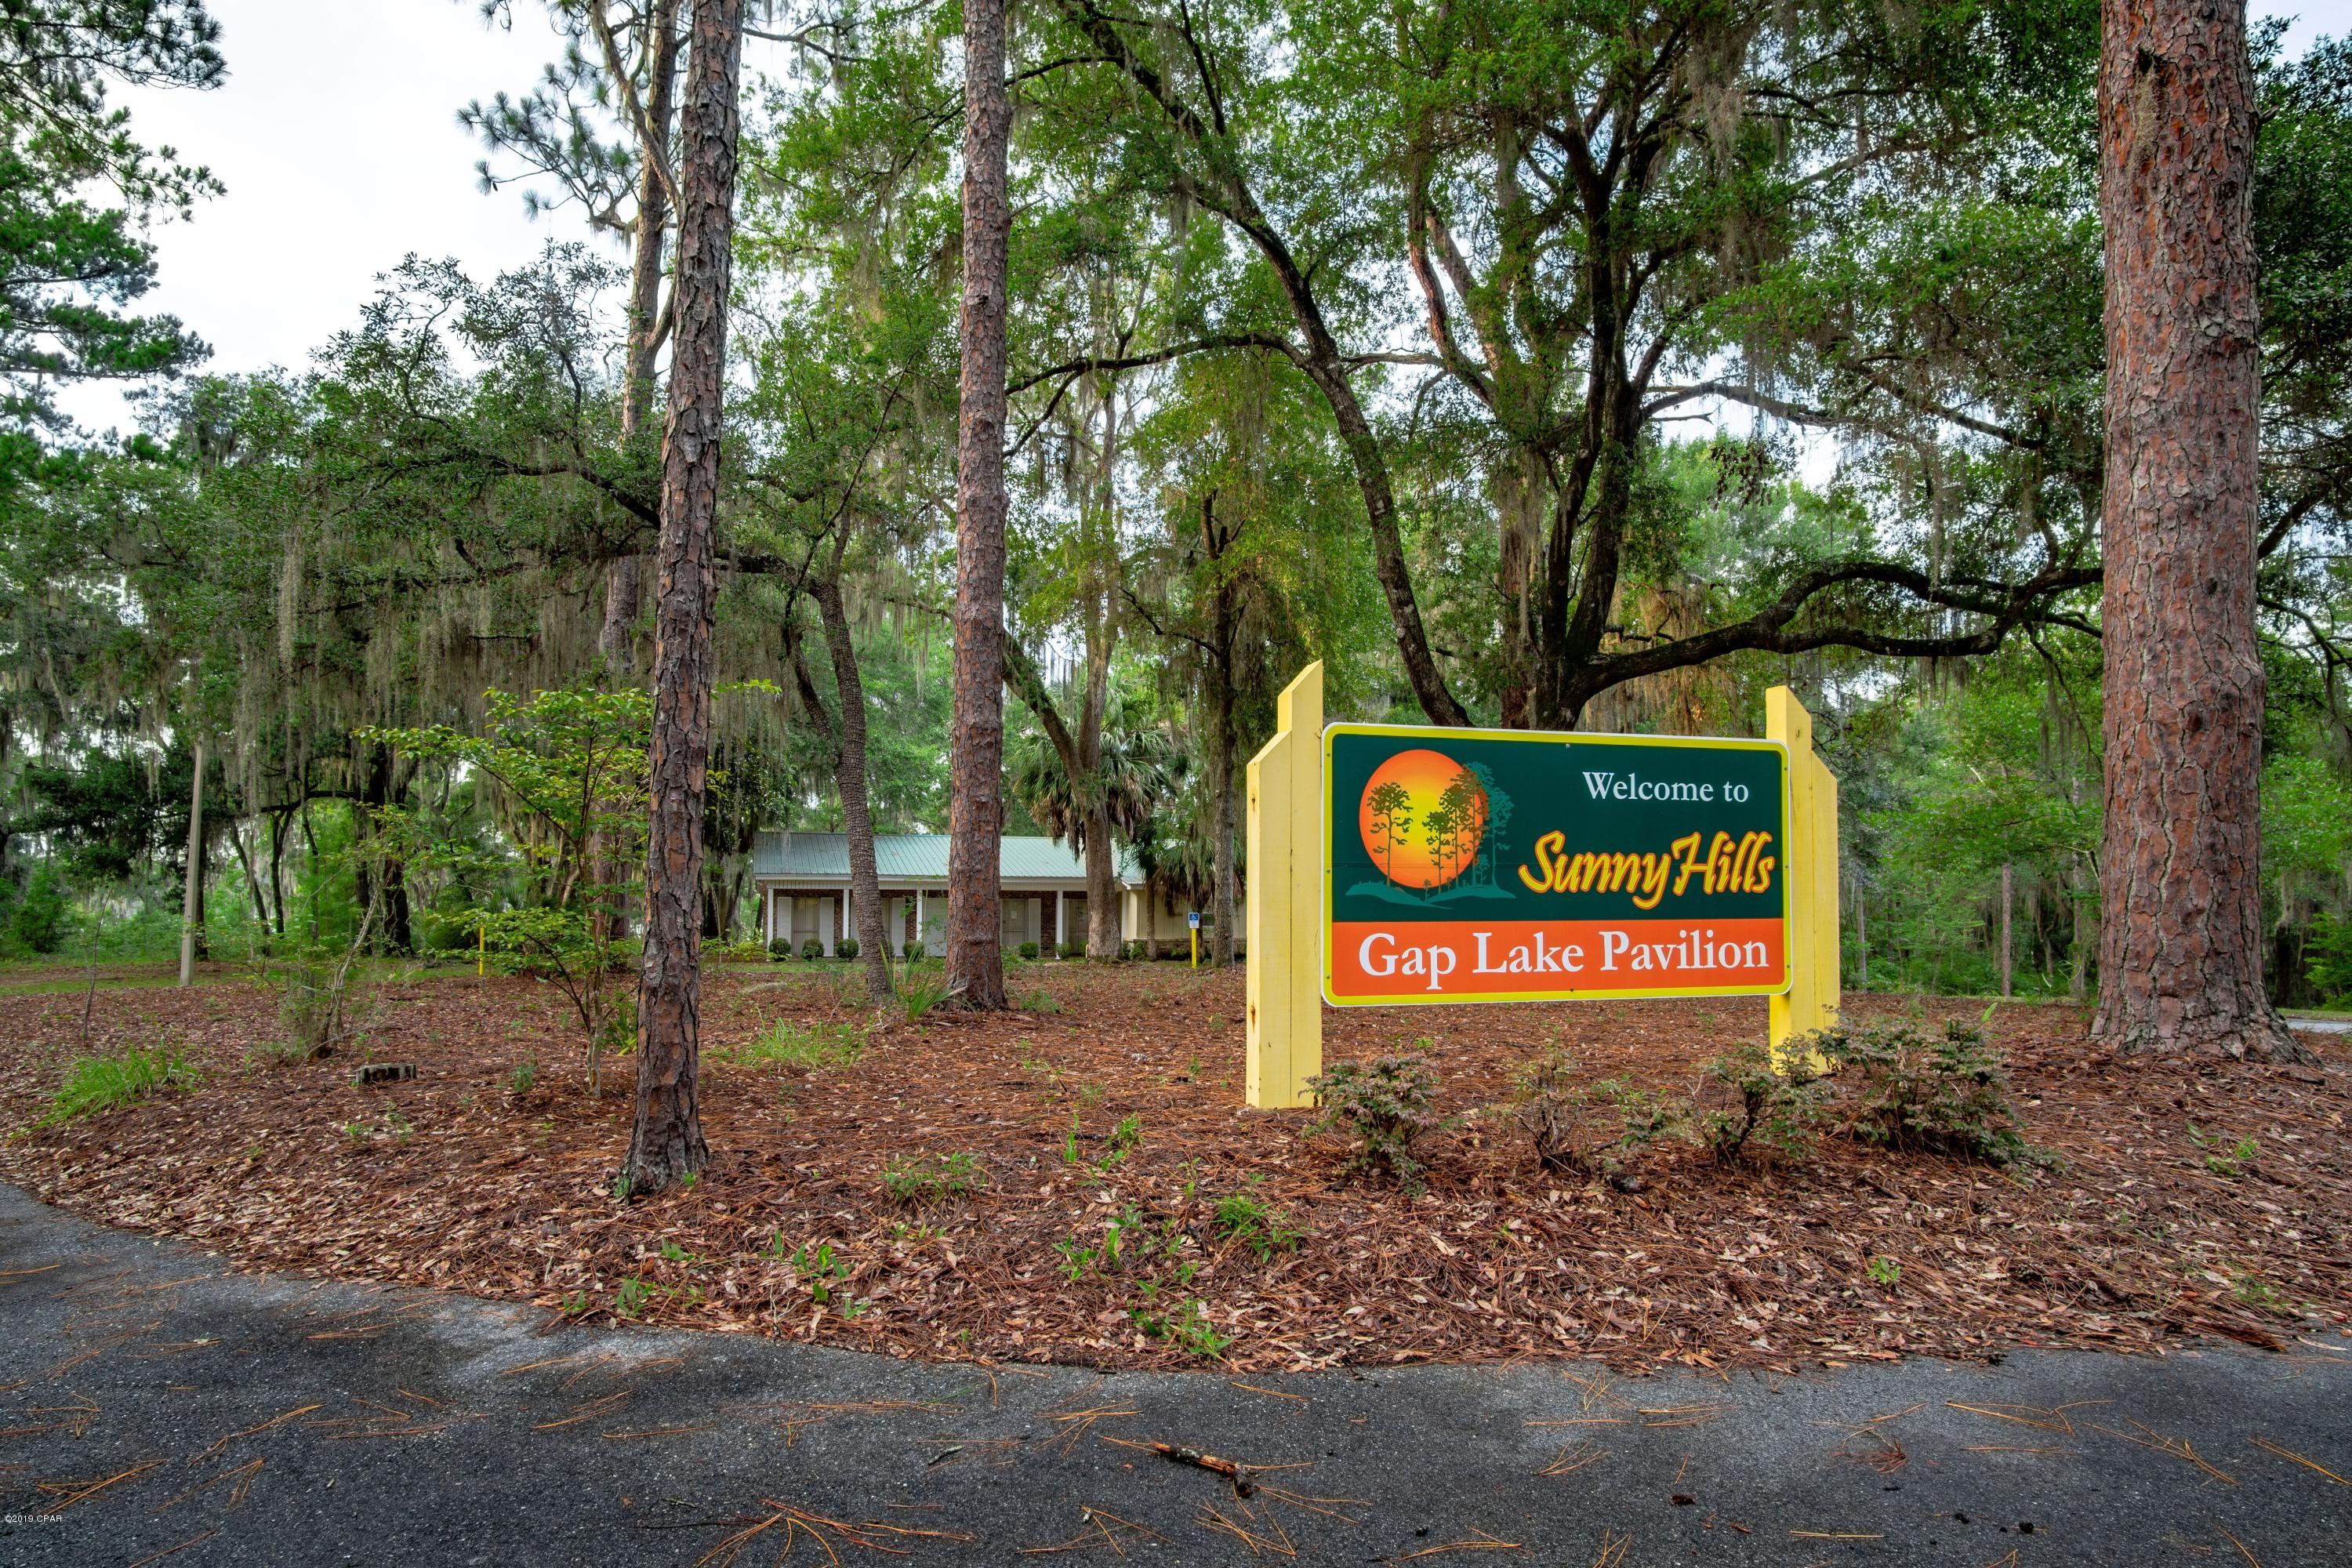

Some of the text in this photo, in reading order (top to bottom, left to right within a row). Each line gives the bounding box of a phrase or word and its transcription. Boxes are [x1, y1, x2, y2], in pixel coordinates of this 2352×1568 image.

[1582, 771, 1749, 803] Welcome to
[1518, 829, 1775, 910] Sunny Hills
[1358, 929, 1769, 990] Gap Lake Pavilion
